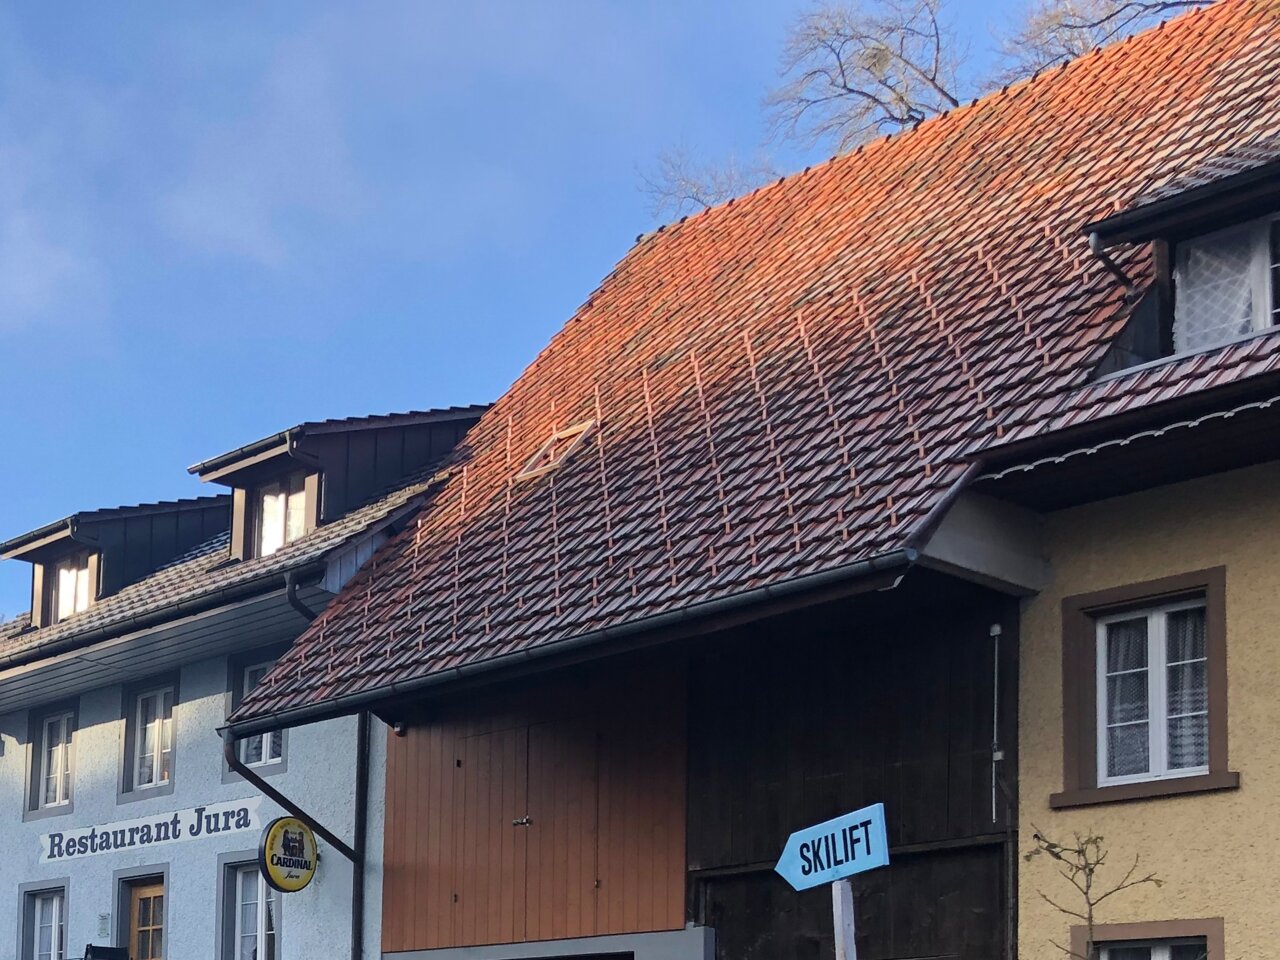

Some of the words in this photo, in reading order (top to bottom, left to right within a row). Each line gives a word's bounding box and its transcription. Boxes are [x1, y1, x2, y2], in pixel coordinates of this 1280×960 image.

[47, 813, 181, 859] Restaurant
[189, 807, 251, 837] Jura
[799, 818, 873, 876] SKILIFT
[270, 853, 313, 871] CARDINAL
